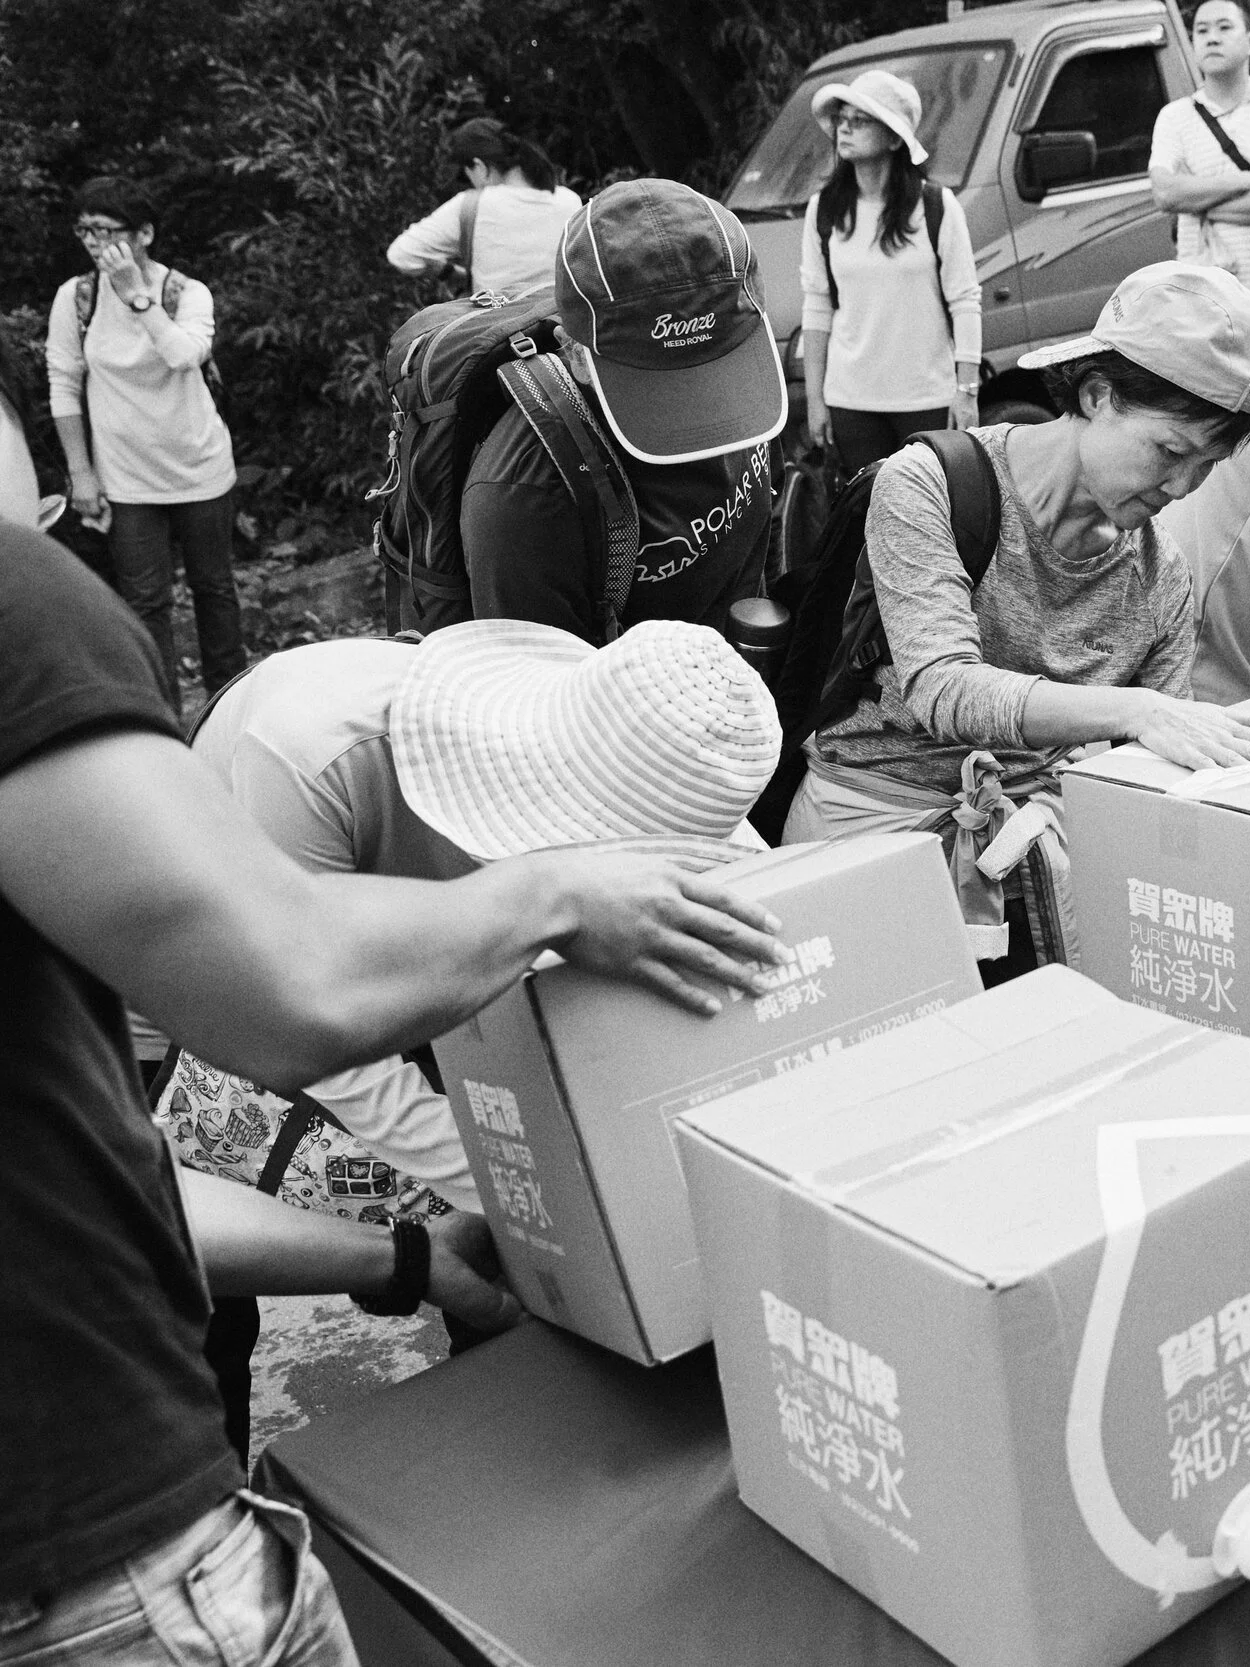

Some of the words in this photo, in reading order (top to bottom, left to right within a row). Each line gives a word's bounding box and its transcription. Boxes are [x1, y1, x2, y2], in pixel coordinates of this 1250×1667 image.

[651, 313, 715, 339] Bronze
[663, 339, 686, 348] HEED
[687, 334, 712, 345] ROYAL
[690, 471, 753, 545] POLAR
[700, 494, 752, 556] SINCE
[1130, 922, 1170, 951] PURE
[1173, 934, 1236, 969] WATER
[1130, 944, 1238, 1013] 純淨水
[823, 1384, 905, 1458] WATER
[1166, 1372, 1236, 1434] PURE
[775, 1383, 911, 1519] 純淨水
